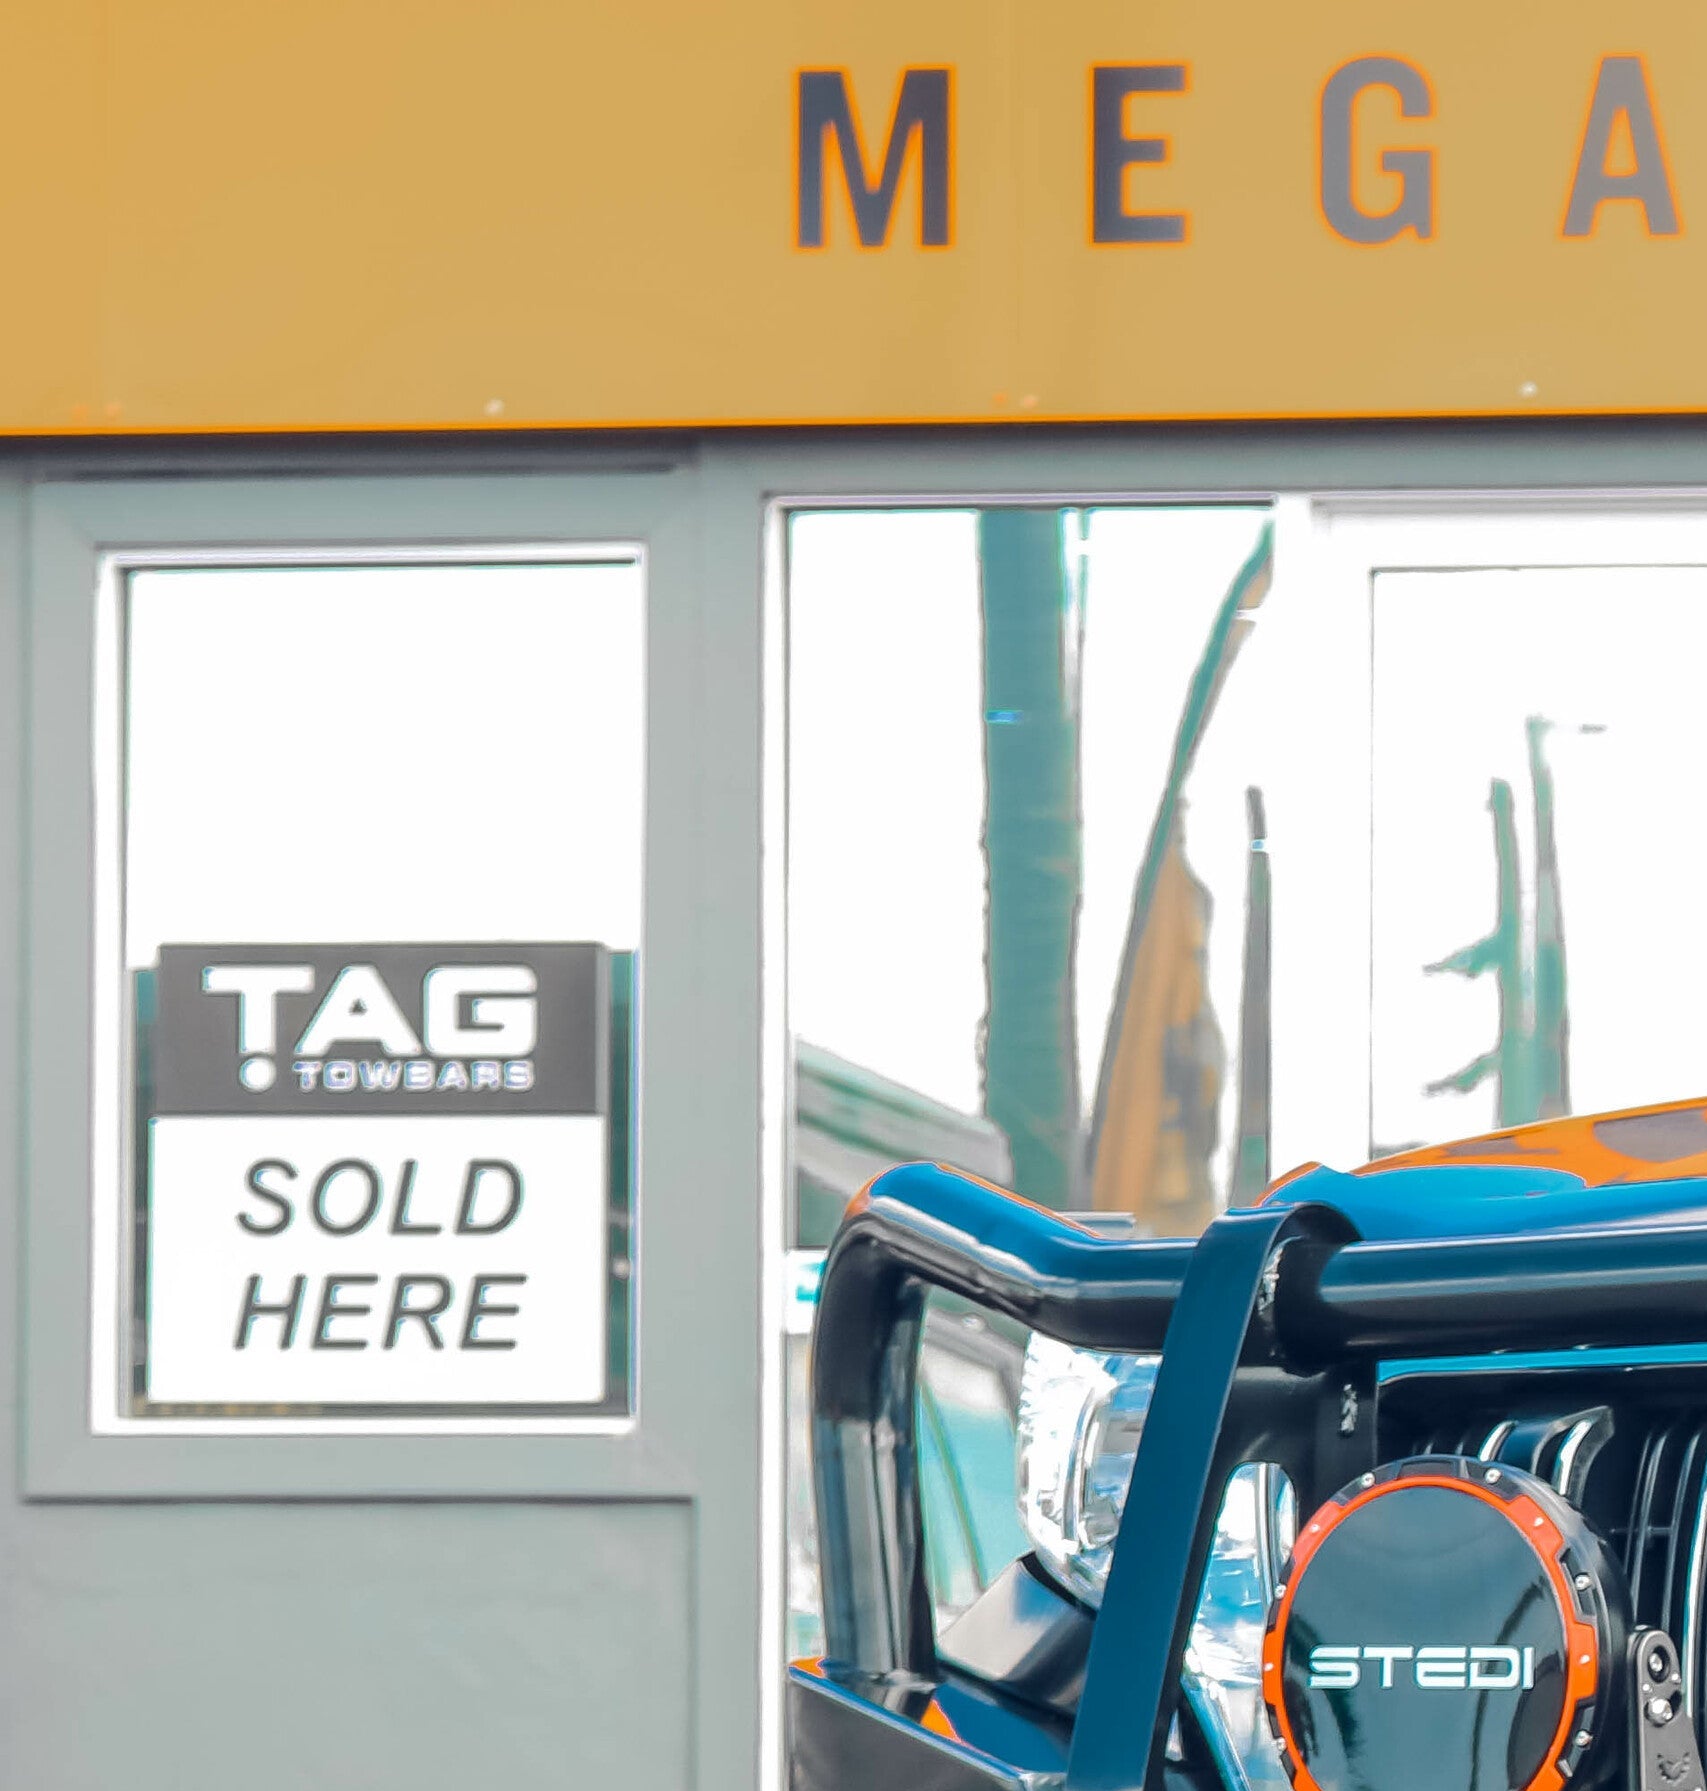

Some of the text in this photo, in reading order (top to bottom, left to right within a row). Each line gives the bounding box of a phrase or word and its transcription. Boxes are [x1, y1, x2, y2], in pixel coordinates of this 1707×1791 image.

[203, 964, 538, 1057] TAG
[293, 1060, 537, 1092] TOWBARS
[237, 1158, 524, 1236] SOLD
[232, 1273, 528, 1350] HERE
[1308, 1643, 1536, 1691] STEDI
